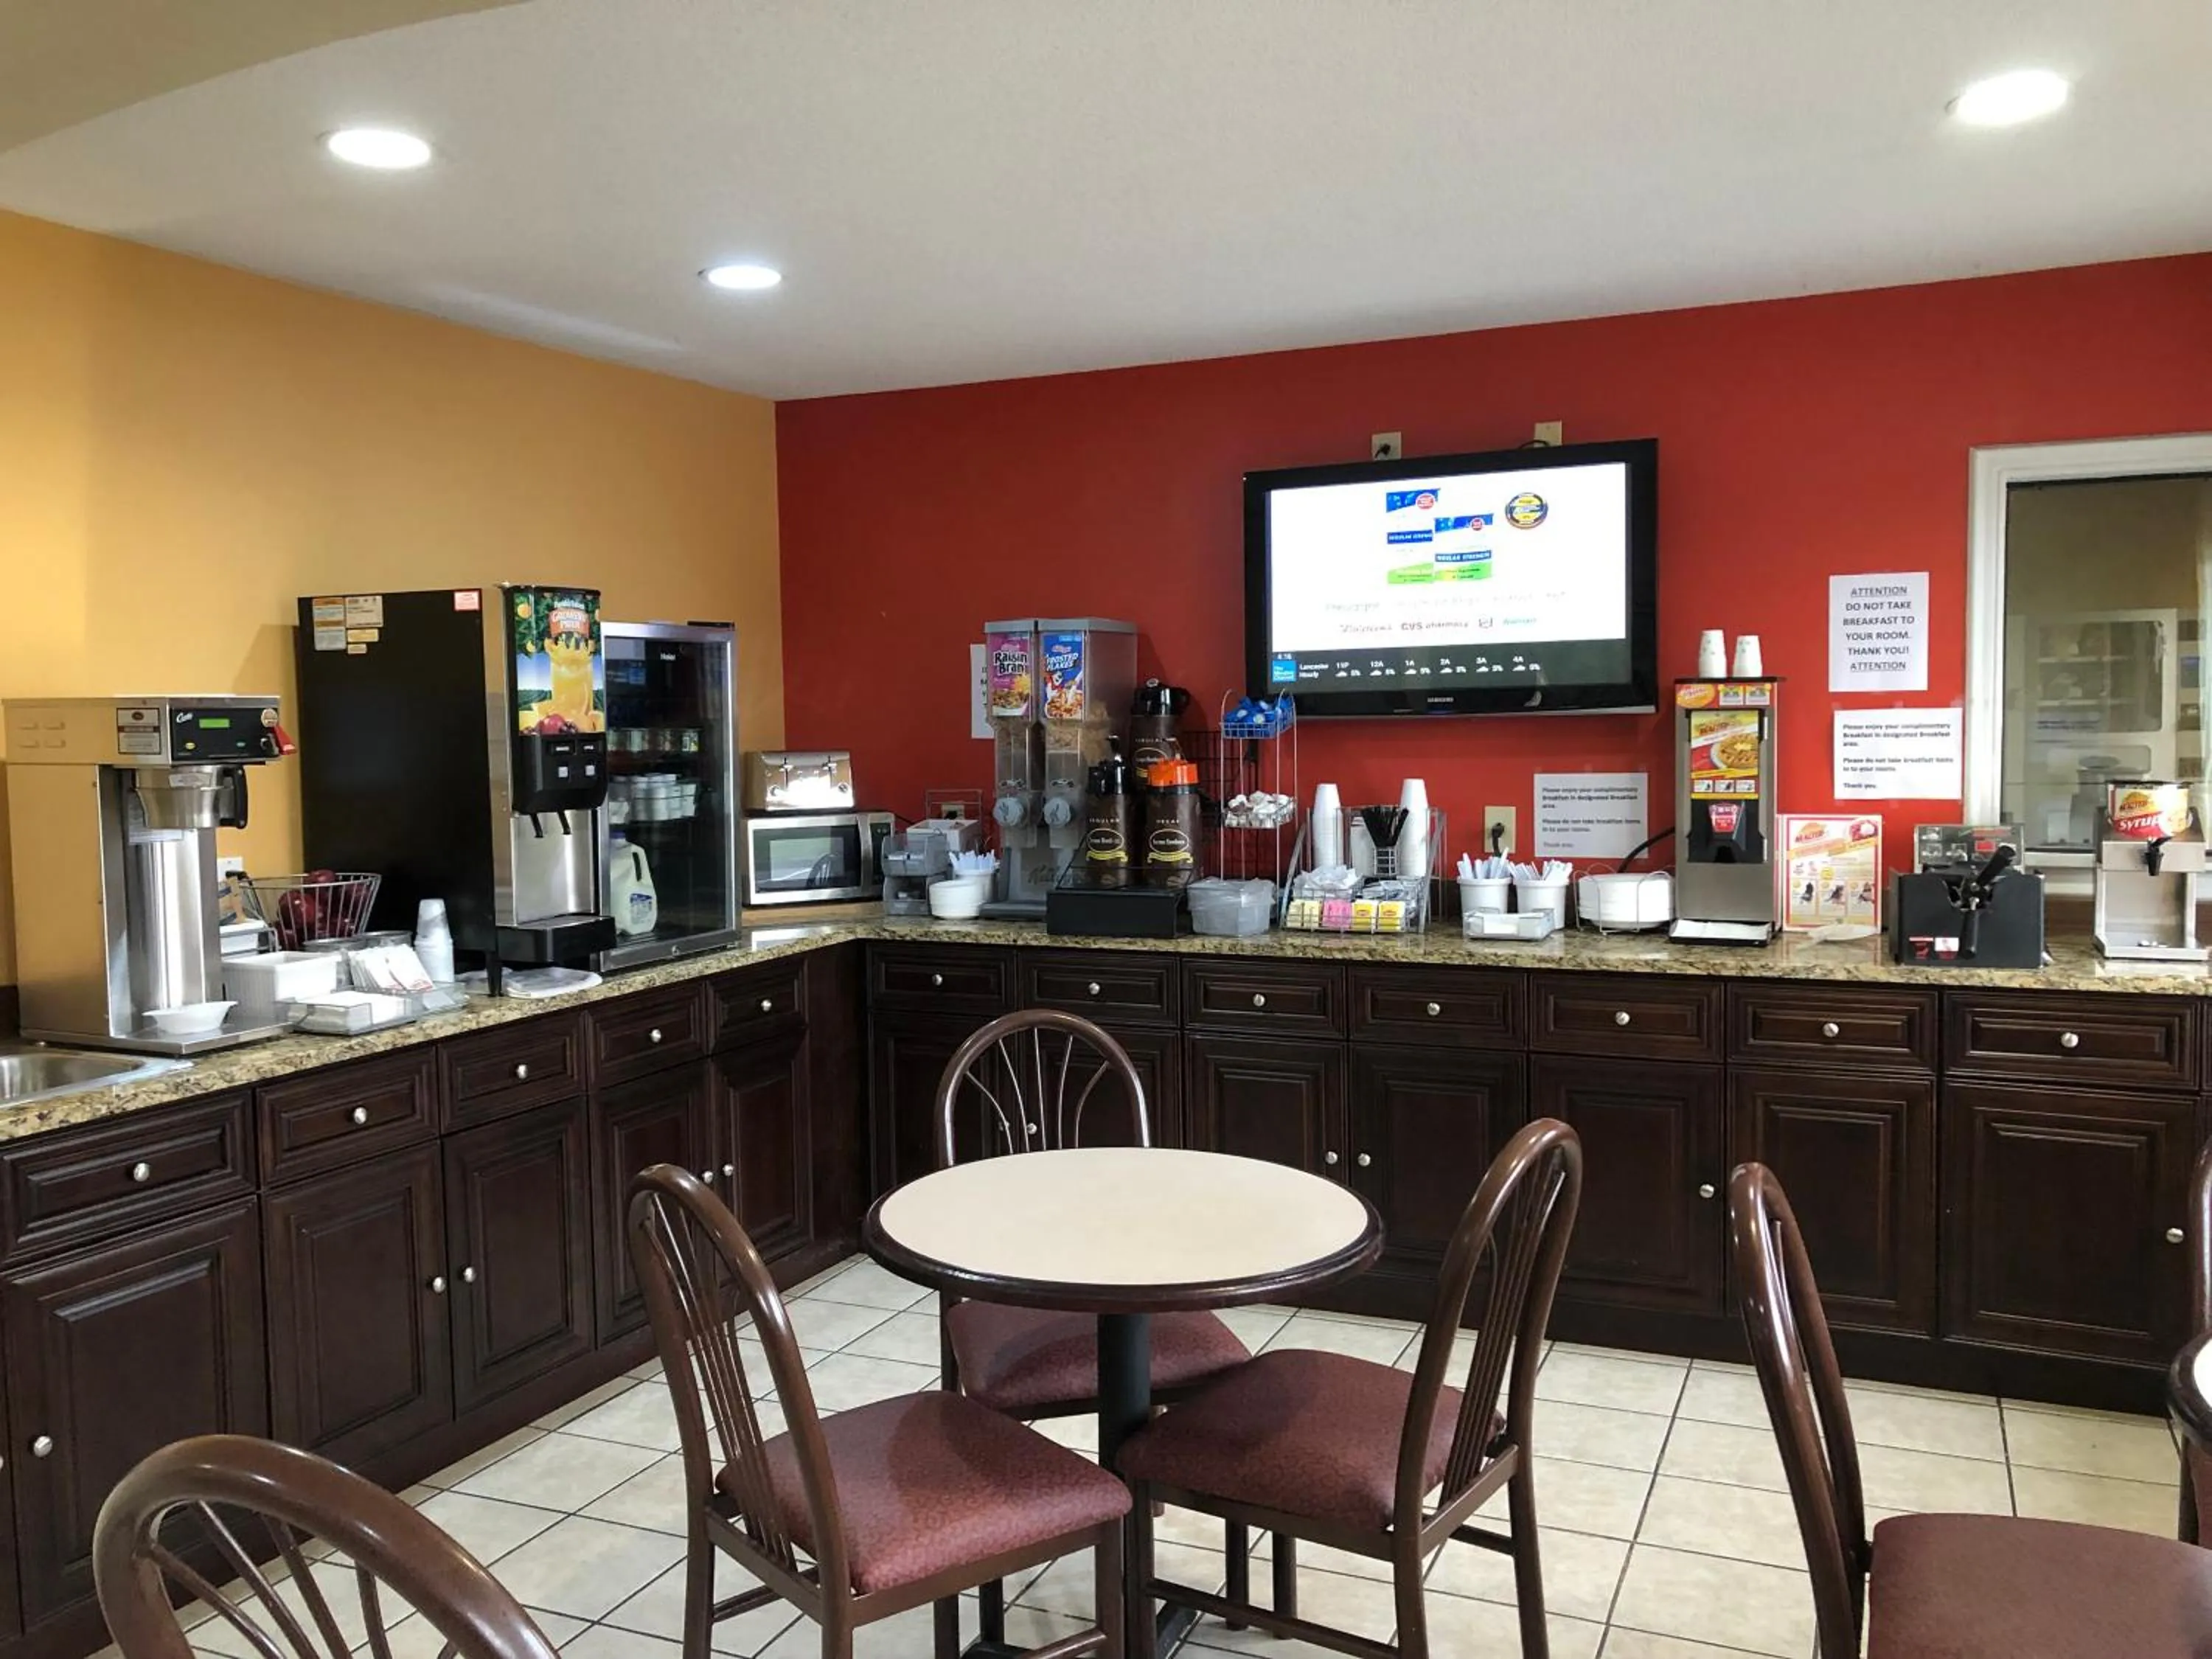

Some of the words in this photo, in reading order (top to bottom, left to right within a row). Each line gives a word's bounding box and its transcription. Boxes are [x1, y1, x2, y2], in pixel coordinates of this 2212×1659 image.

[1851, 586, 1908, 597] ATTENTION
[1846, 602, 1861, 611] DO
[1863, 602, 1884, 611] NOT
[1887, 601, 1912, 610] TAKE
[1401, 622, 1423, 630] CVS
[1843, 616, 1899, 626] BREAKFAST
[1901, 616, 1915, 625] TO
[1846, 632, 1874, 641] YOUR
[1848, 647, 1882, 655] THANK
[994, 651, 1028, 664] Raisin
[999, 664, 1024, 674] Bran
[1850, 661, 1906, 672] ATTENTION
